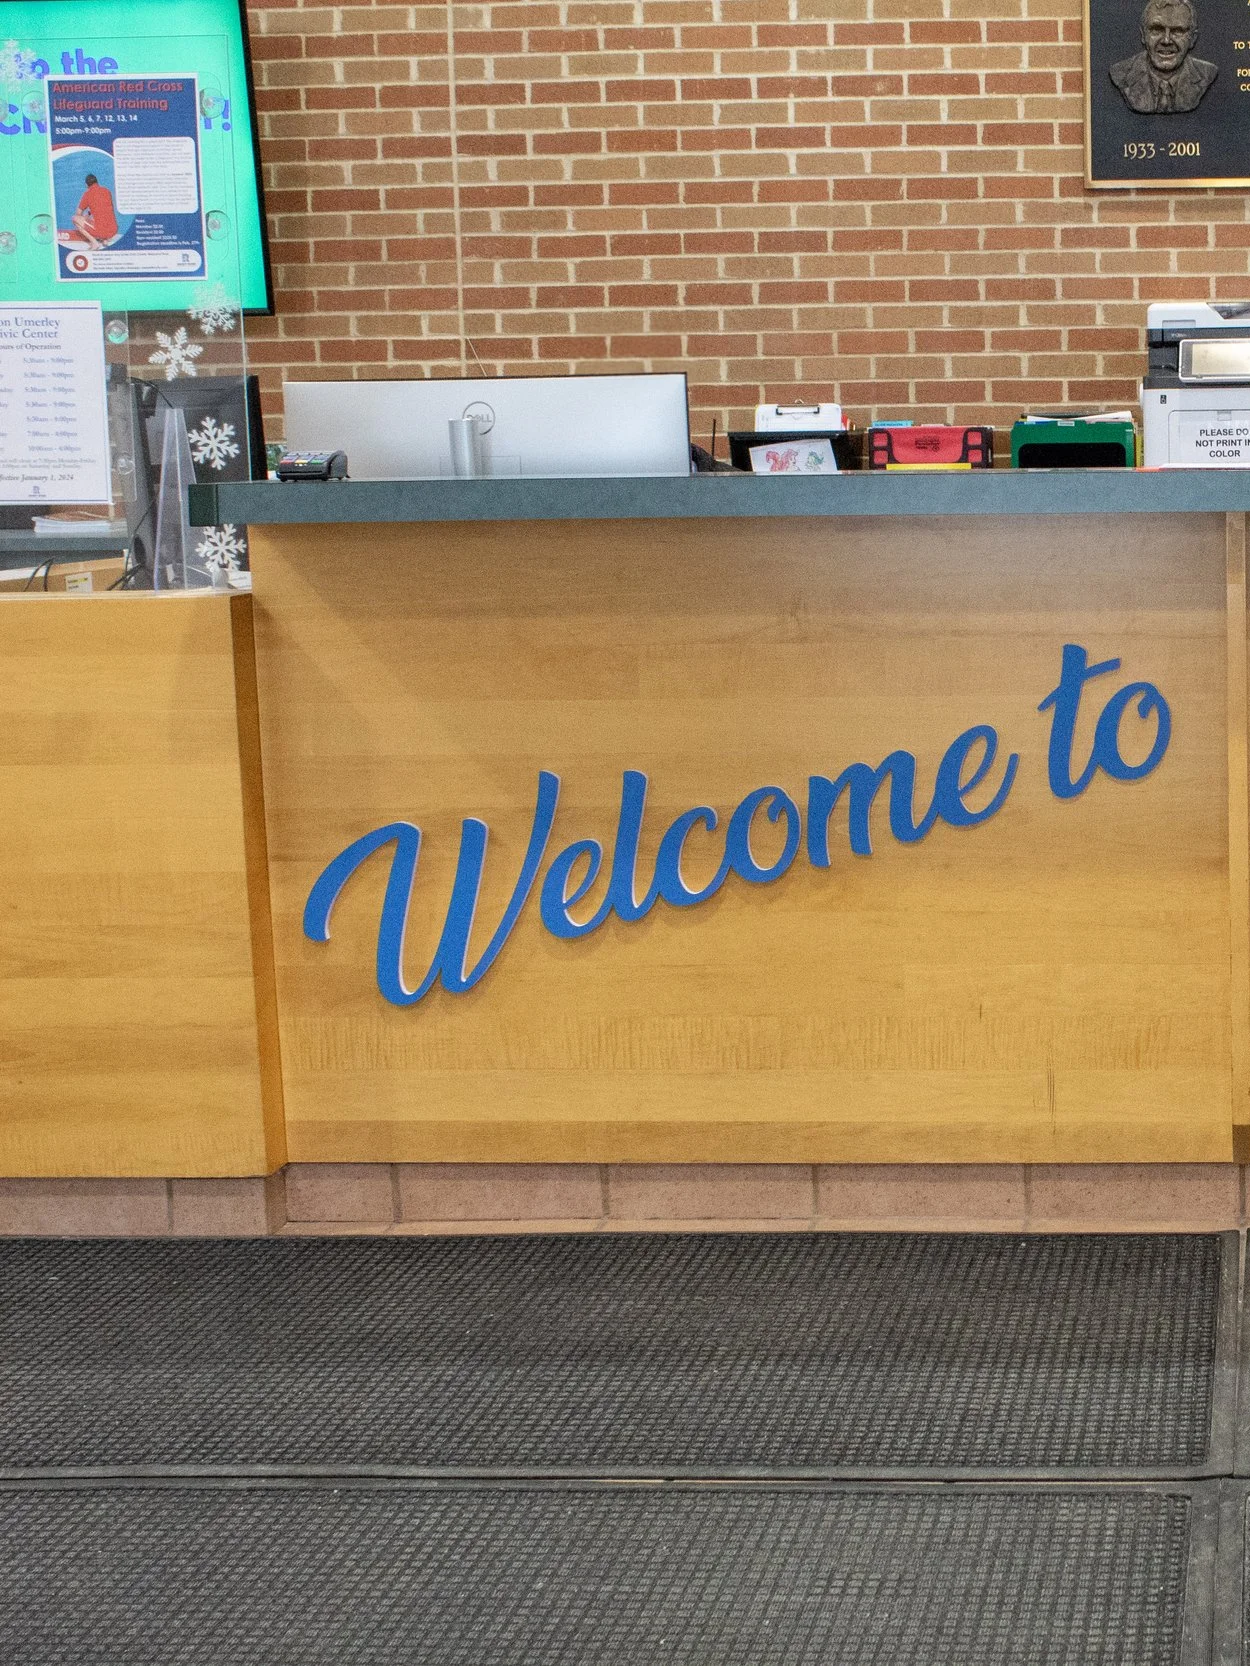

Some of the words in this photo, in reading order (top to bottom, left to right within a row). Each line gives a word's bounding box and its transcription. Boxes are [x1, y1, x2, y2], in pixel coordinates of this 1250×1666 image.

[1233, 41, 1246, 49] TO
[52, 82, 115, 94] American
[119, 81, 144, 93] Red
[148, 80, 183, 92] Cross
[53, 98, 113, 112] Lifeguard
[117, 97, 169, 112] Training
[54, 115, 78, 123] March
[55, 127, 112, 136] 5:00pm-9:00pm
[1123, 142, 1156, 160] 1933
[1168, 141, 1201, 157] 2001
[14, 316, 61, 330] Umerley
[22, 329, 58, 338] Center
[25, 343, 62, 352] Operation
[1199, 428, 1234, 437] PLEASE
[1236, 427, 1250, 436] DO
[1195, 440, 1214, 448] NOT
[1216, 439, 1242, 447] PRINT
[1209, 450, 1241, 458] COLOR
[20, 473, 48, 482] January
[303, 724, 1020, 1006] Welcome
[1037, 643, 1173, 799] to
